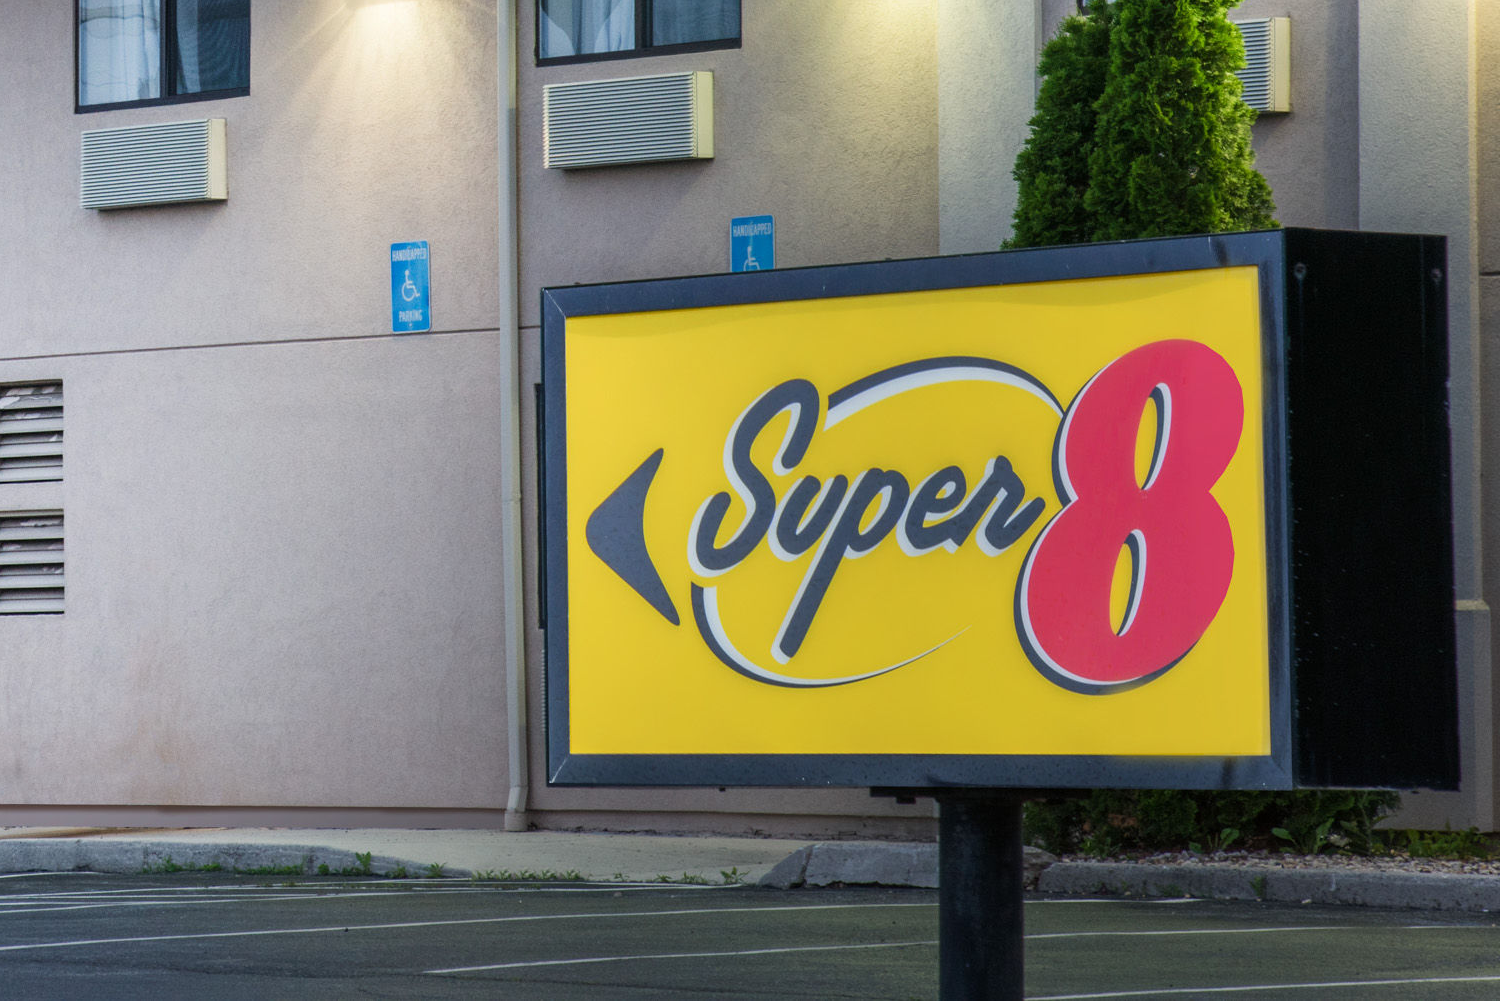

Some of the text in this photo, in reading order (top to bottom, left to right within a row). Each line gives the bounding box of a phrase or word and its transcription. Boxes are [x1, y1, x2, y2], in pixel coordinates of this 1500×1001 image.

[399, 309, 423, 323] PARKING
[687, 339, 1245, 696] Super 8
